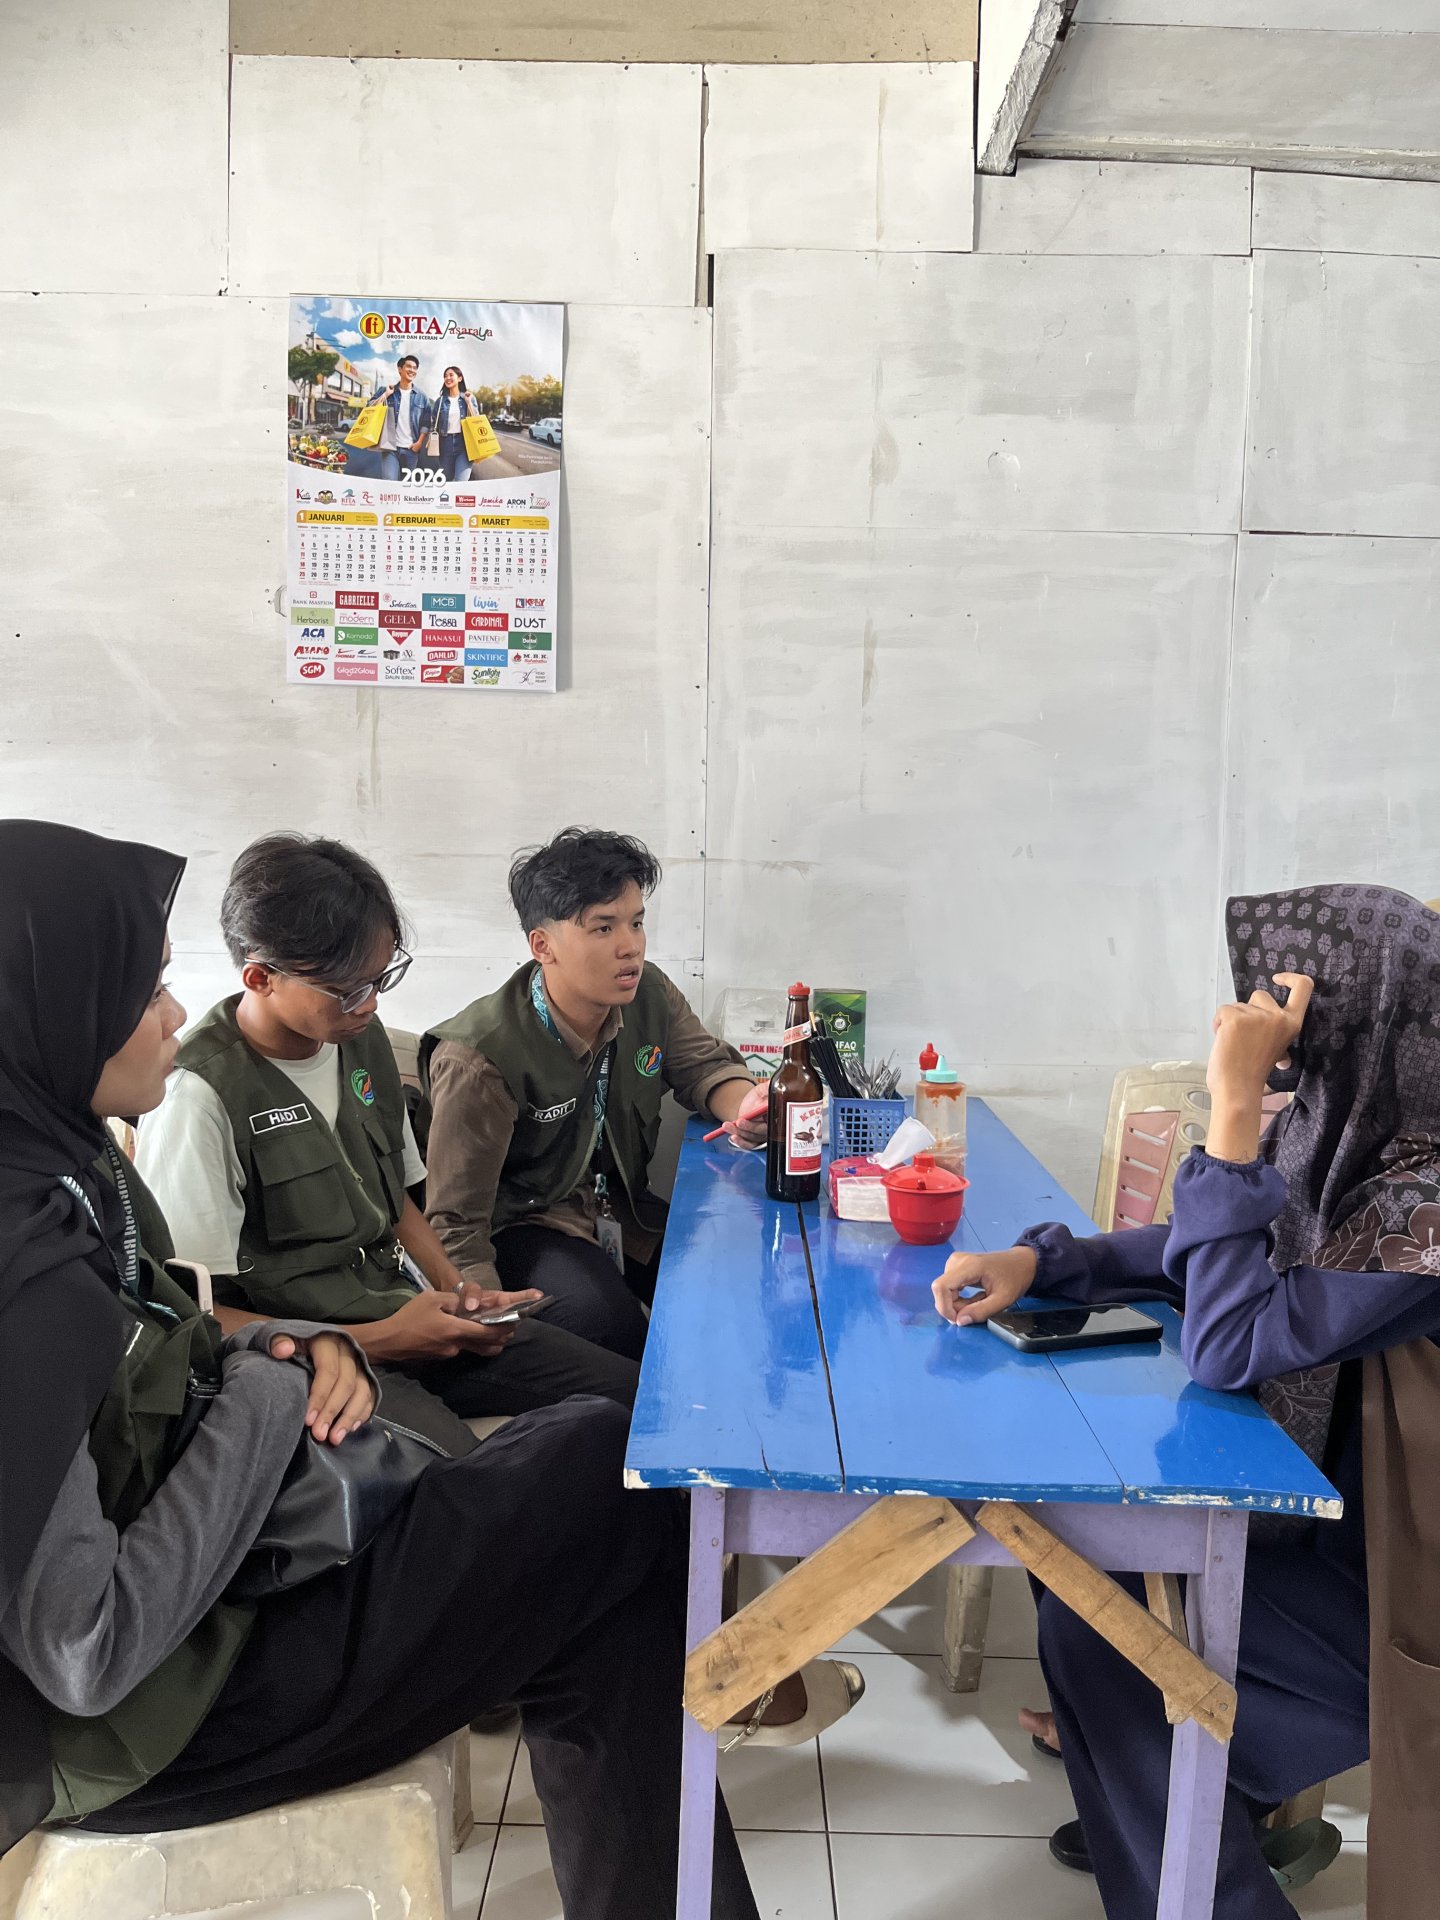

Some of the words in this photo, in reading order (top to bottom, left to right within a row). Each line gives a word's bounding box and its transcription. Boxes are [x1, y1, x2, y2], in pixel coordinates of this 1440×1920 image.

[387, 315, 442, 334] RITA
[440, 320, 493, 341] Pasaraya
[402, 468, 446, 488] 2026
[340, 595, 375, 606] GABRIELLE
[390, 600, 416, 608] Selection
[432, 598, 454, 606] MCB
[297, 616, 329, 624] Herborist
[340, 614, 374, 622] modern
[384, 614, 416, 624] GEELA
[429, 614, 457, 627] Tessa
[471, 616, 503, 627] CARDINAL
[514, 618, 546, 628] DUST
[302, 628, 325, 638] ACA
[425, 634, 461, 642] HANASUI
[467, 653, 505, 661] SKINTIFIC
[302, 665, 321, 674] SGM
[385, 665, 413, 675] Softex
[472, 668, 500, 680] Sunlight
[740, 1044, 765, 1053] KOTAK
[535, 1104, 570, 1120] RADIT
[269, 1110, 298, 1125] HADI
